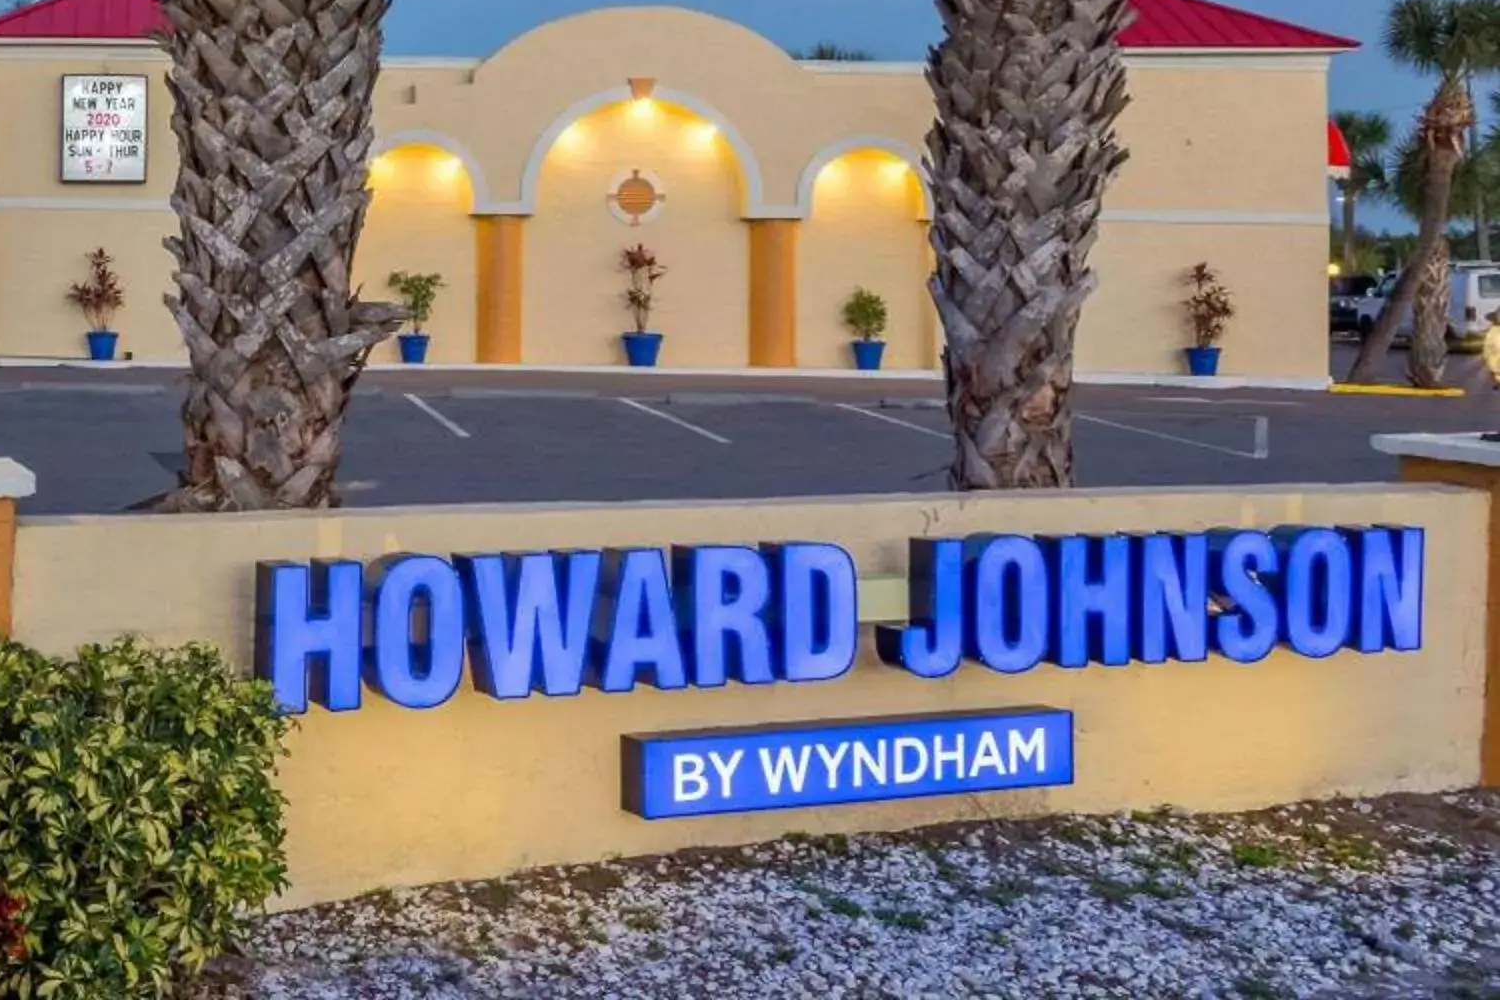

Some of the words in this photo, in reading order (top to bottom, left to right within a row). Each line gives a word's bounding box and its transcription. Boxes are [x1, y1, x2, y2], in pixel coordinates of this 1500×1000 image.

[82, 81, 123, 95] HAPPY
[72, 97, 97, 110] NEW
[105, 98, 136, 110] YEAR
[87, 113, 121, 126] 2020
[65, 129, 105, 142] HAPPY
[111, 129, 143, 142] HOUR
[68, 144, 93, 157] SUN
[257, 541, 857, 714] HOWARD
[878, 524, 1425, 678] JOHNSON
[673, 749, 745, 802] BY
[759, 727, 1046, 795] WYNDHAM
